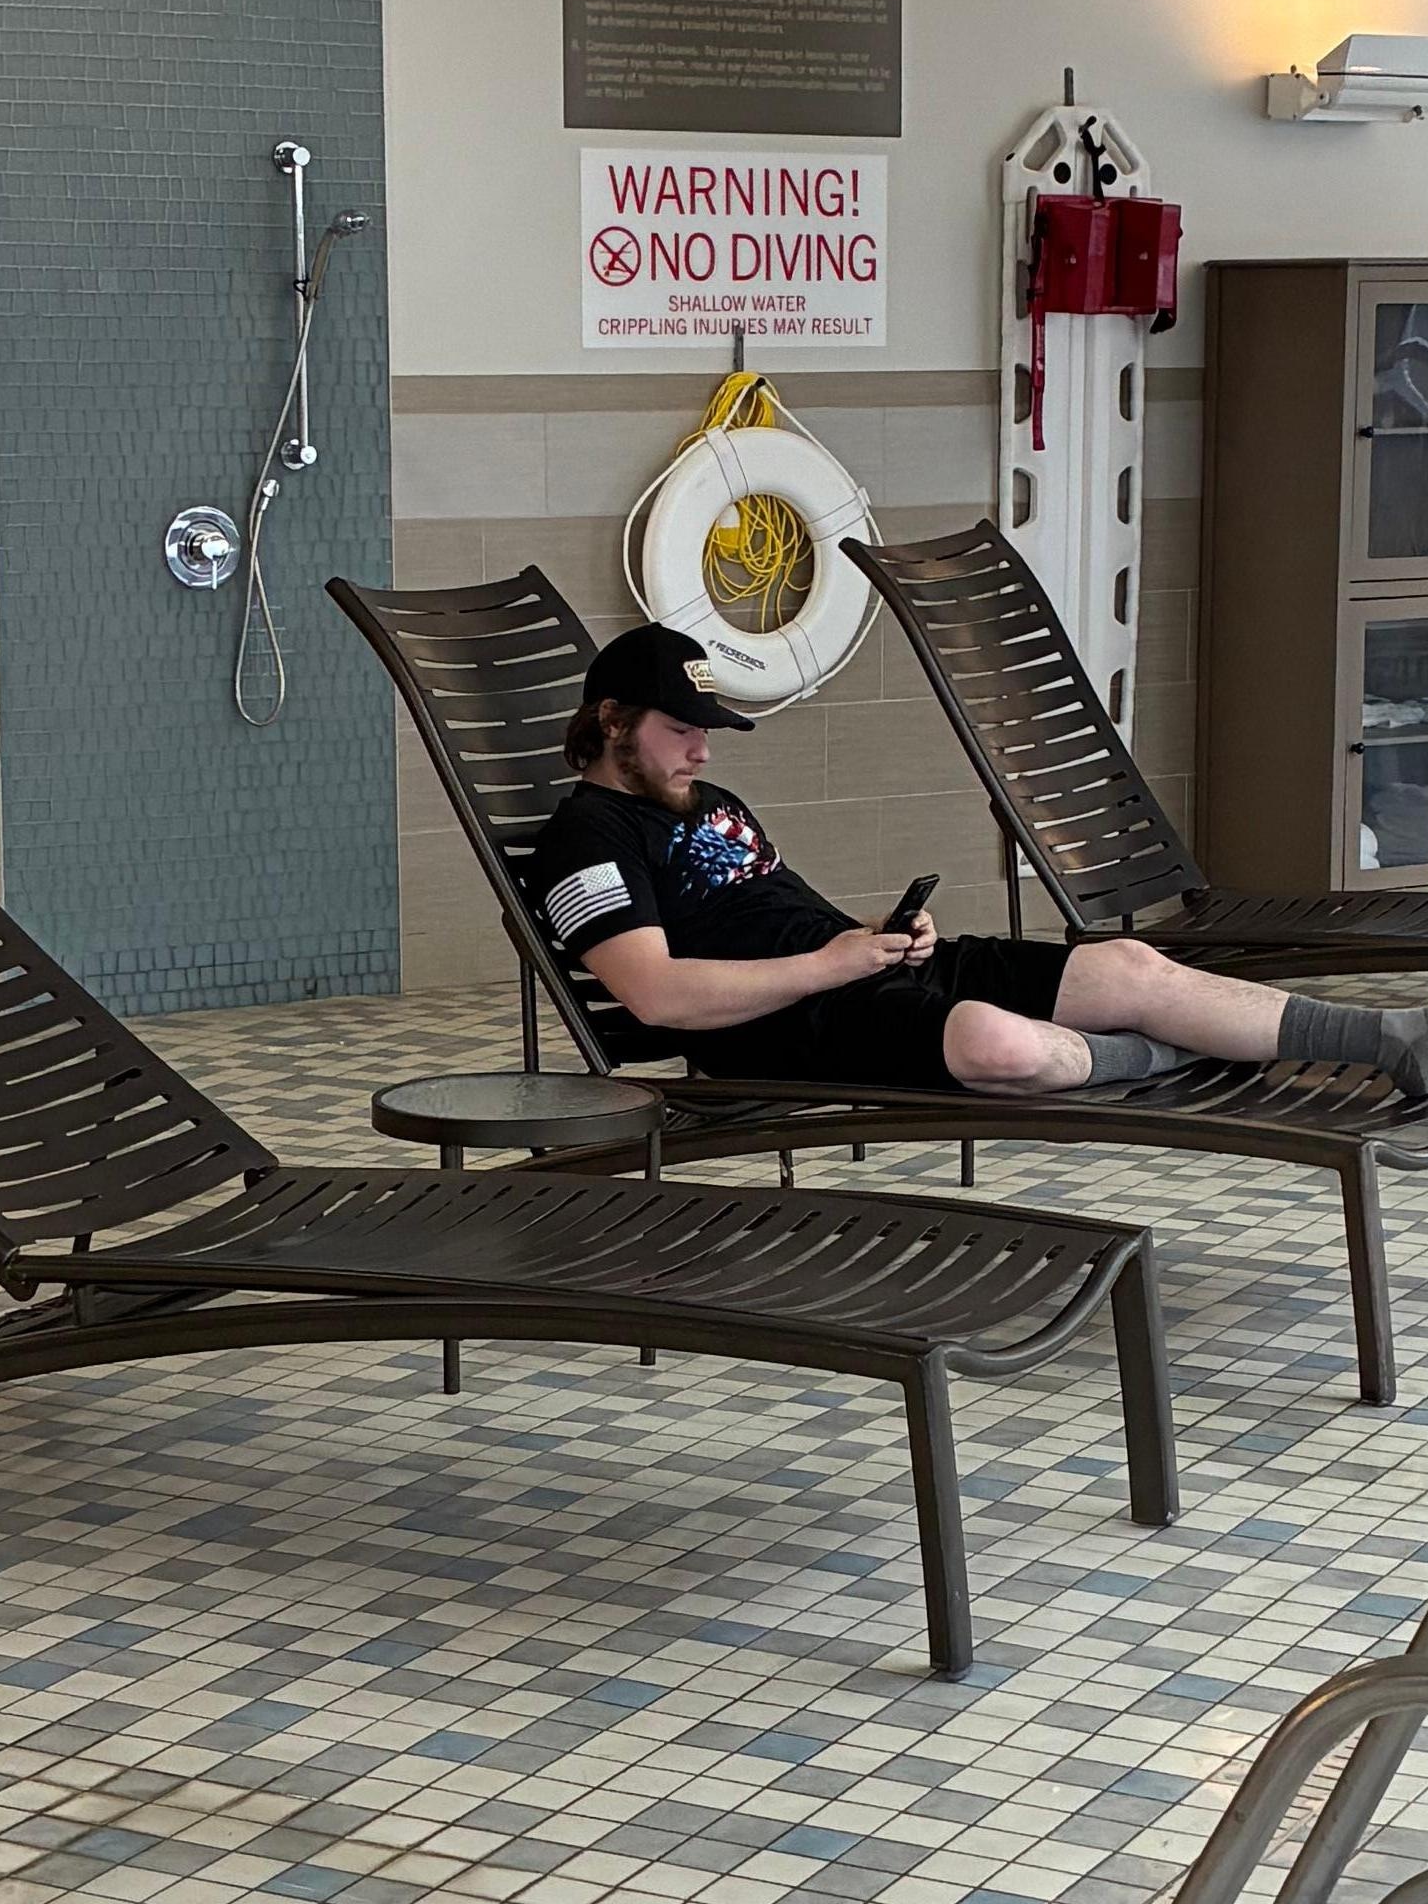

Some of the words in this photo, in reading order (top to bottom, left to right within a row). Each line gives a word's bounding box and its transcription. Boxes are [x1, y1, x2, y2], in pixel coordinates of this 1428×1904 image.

[608, 165, 859, 217] WARNING!
[650, 232, 716, 281] NO
[731, 233, 877, 282] DIVING
[668, 295, 747, 312] SHALLOW
[751, 295, 806, 312] WATER
[598, 318, 687, 335] CRIPPLING
[694, 318, 767, 335] INJURIES
[773, 318, 806, 335] MAY
[811, 317, 873, 335] RESULT
